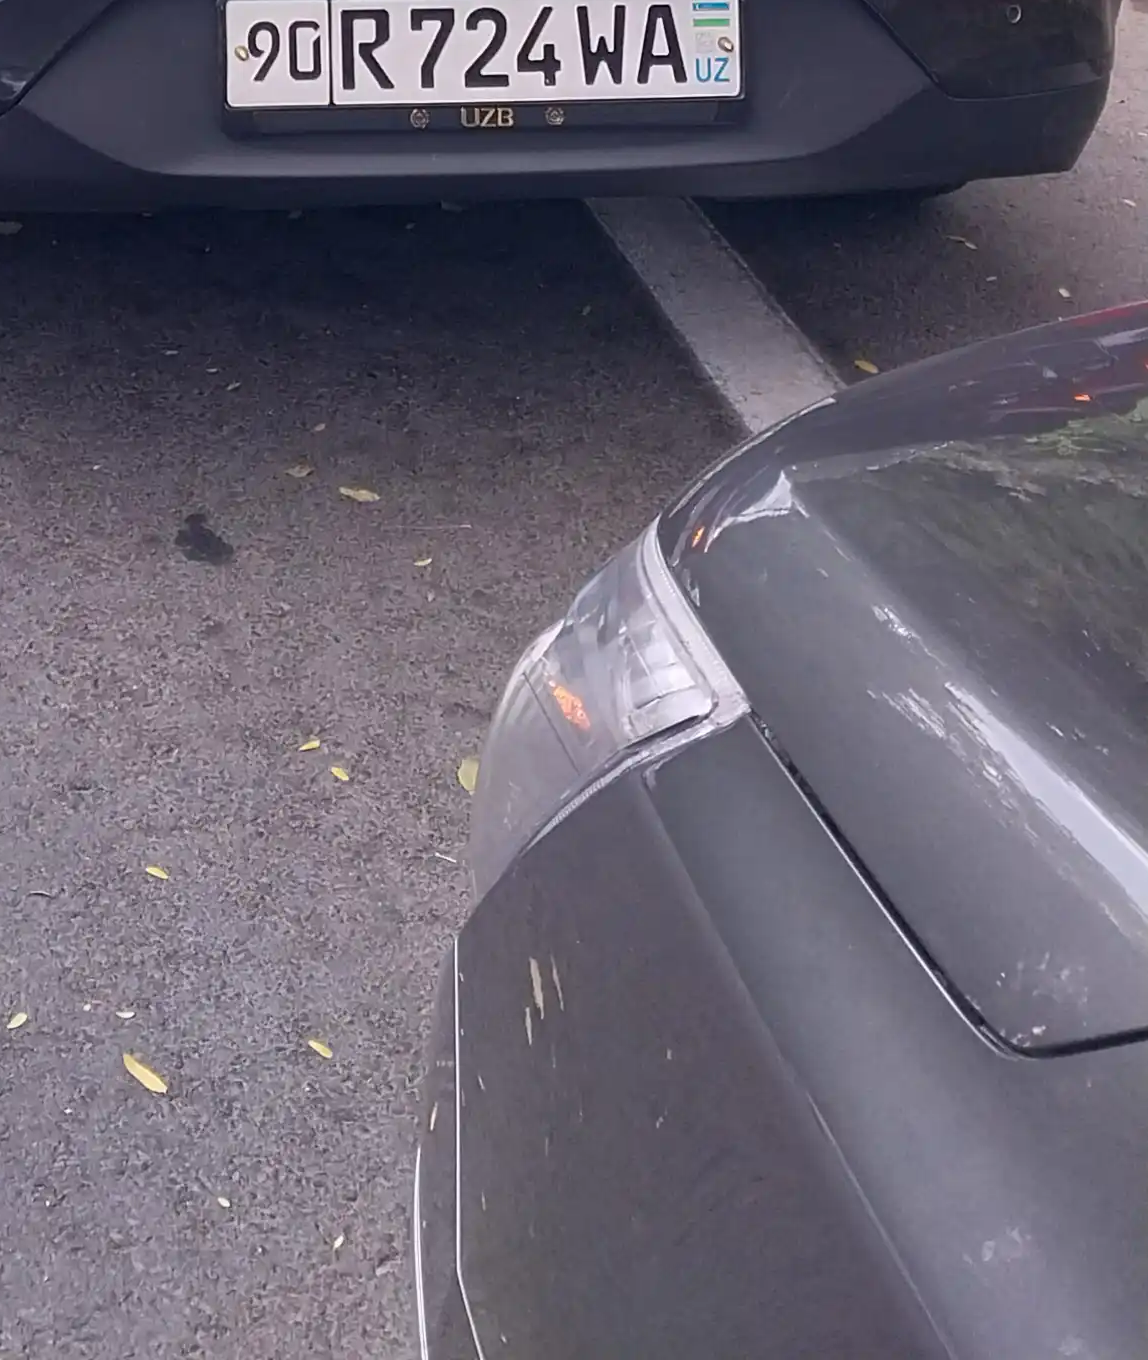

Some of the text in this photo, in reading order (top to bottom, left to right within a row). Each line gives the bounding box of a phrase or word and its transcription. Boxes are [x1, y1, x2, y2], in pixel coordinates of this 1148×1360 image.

[247, 20, 322, 81] 90
[695, 56, 730, 83] UZ
[460, 106, 514, 128] UZB
